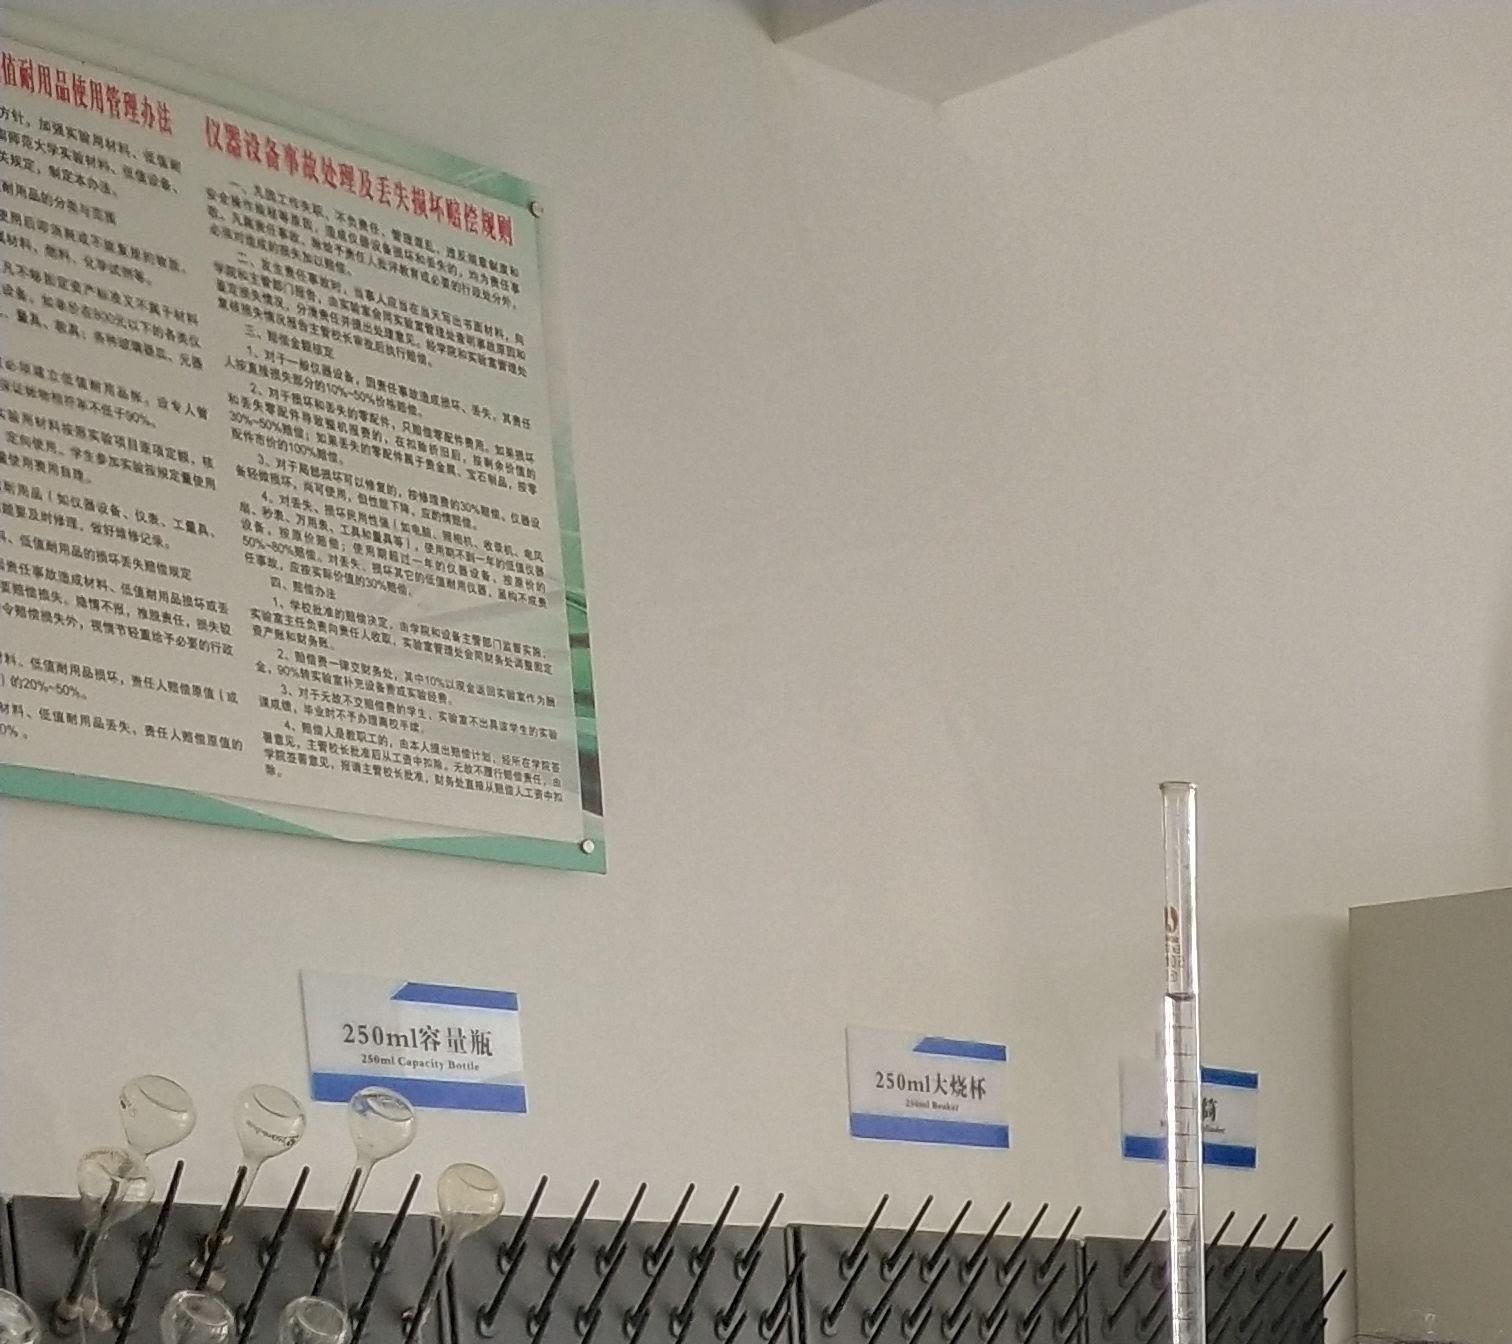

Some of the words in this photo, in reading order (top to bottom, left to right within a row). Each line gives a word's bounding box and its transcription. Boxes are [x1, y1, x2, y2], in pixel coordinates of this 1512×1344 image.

[203, 115, 512, 246] 仪器设备事故处理及丢失损坏赔偿规则
[270, 575, 335, 600] 四、赔偿办法
[264, 763, 282, 777] 除。
[343, 1023, 493, 1056] 250ml容量瓶
[361, 1054, 395, 1066] 250ml
[398, 1056, 444, 1070] Capacity
[448, 1059, 480, 1072] Bottle
[875, 1071, 987, 1101] 250ml大烧杯
